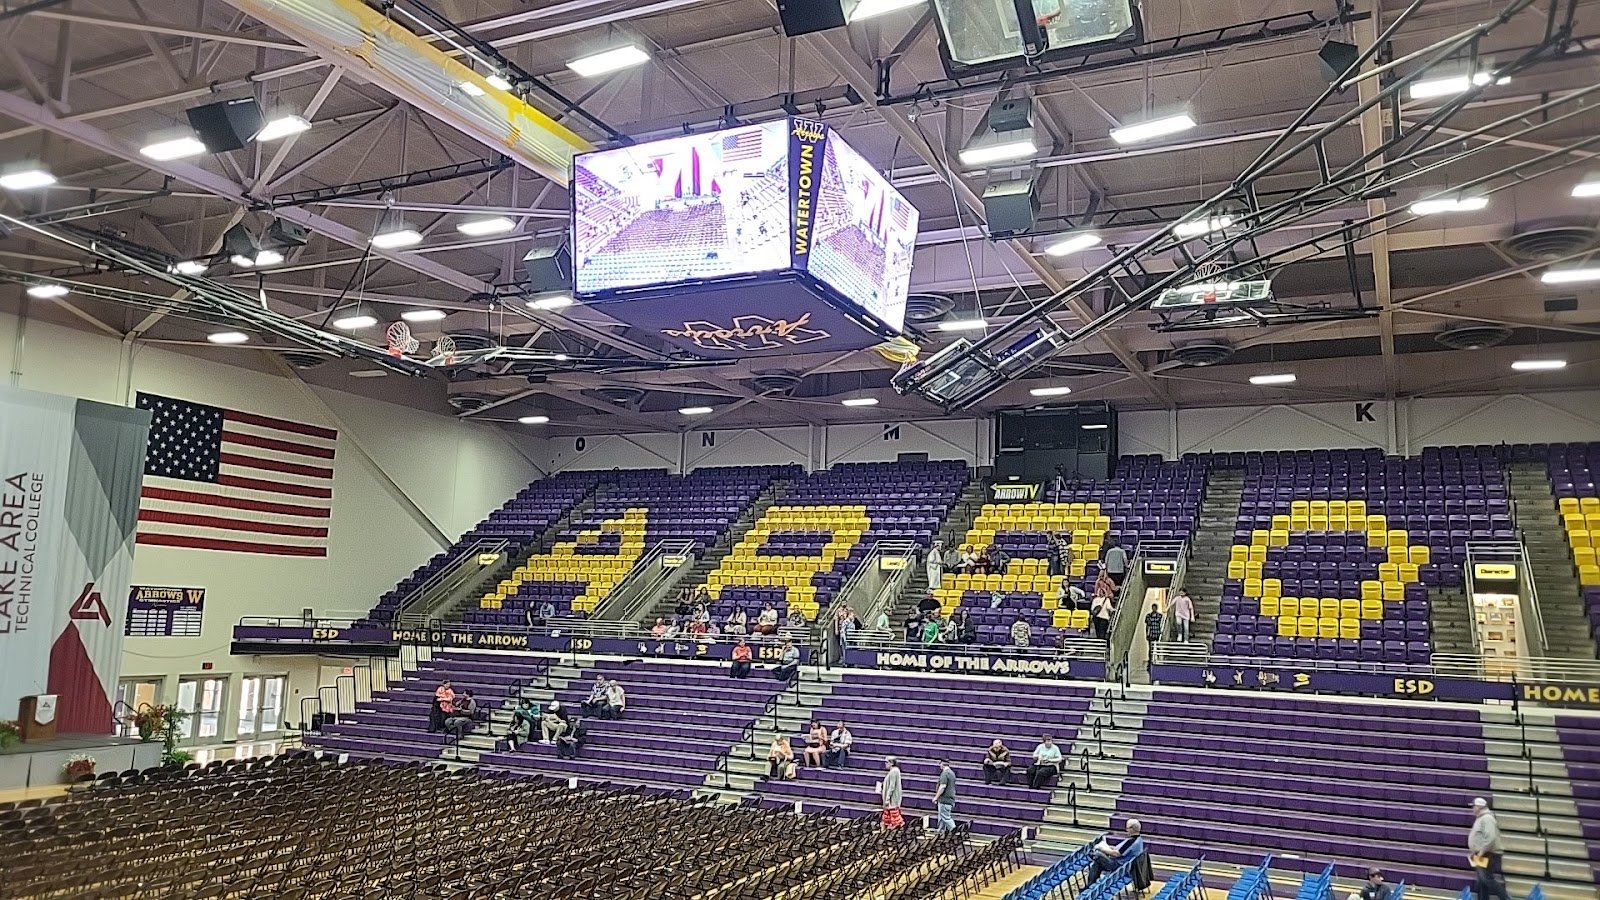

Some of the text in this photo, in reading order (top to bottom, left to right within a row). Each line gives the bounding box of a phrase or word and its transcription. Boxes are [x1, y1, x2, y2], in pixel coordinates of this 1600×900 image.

[794, 144, 814, 256] WATERTOWN
[1355, 402, 1376, 423] K
[701, 432, 715, 447] N
[883, 423, 900, 441] M
[0, 472, 28, 552] AREA
[15, 472, 44, 633] TECHNICAL COLLEGE
[135, 589, 184, 601] ARROWS
[186, 589, 204, 604] W
[312, 628, 339, 640] ESD
[431, 632, 446, 642] OF
[451, 632, 473, 644] THE
[478, 634, 528, 646] ARROWS
[759, 646, 783, 659] ESD
[877, 652, 1070, 675] HOME OF THE ARROWS
[1393, 678, 1434, 695] ESD
[1523, 684, 1600, 703] HOME
